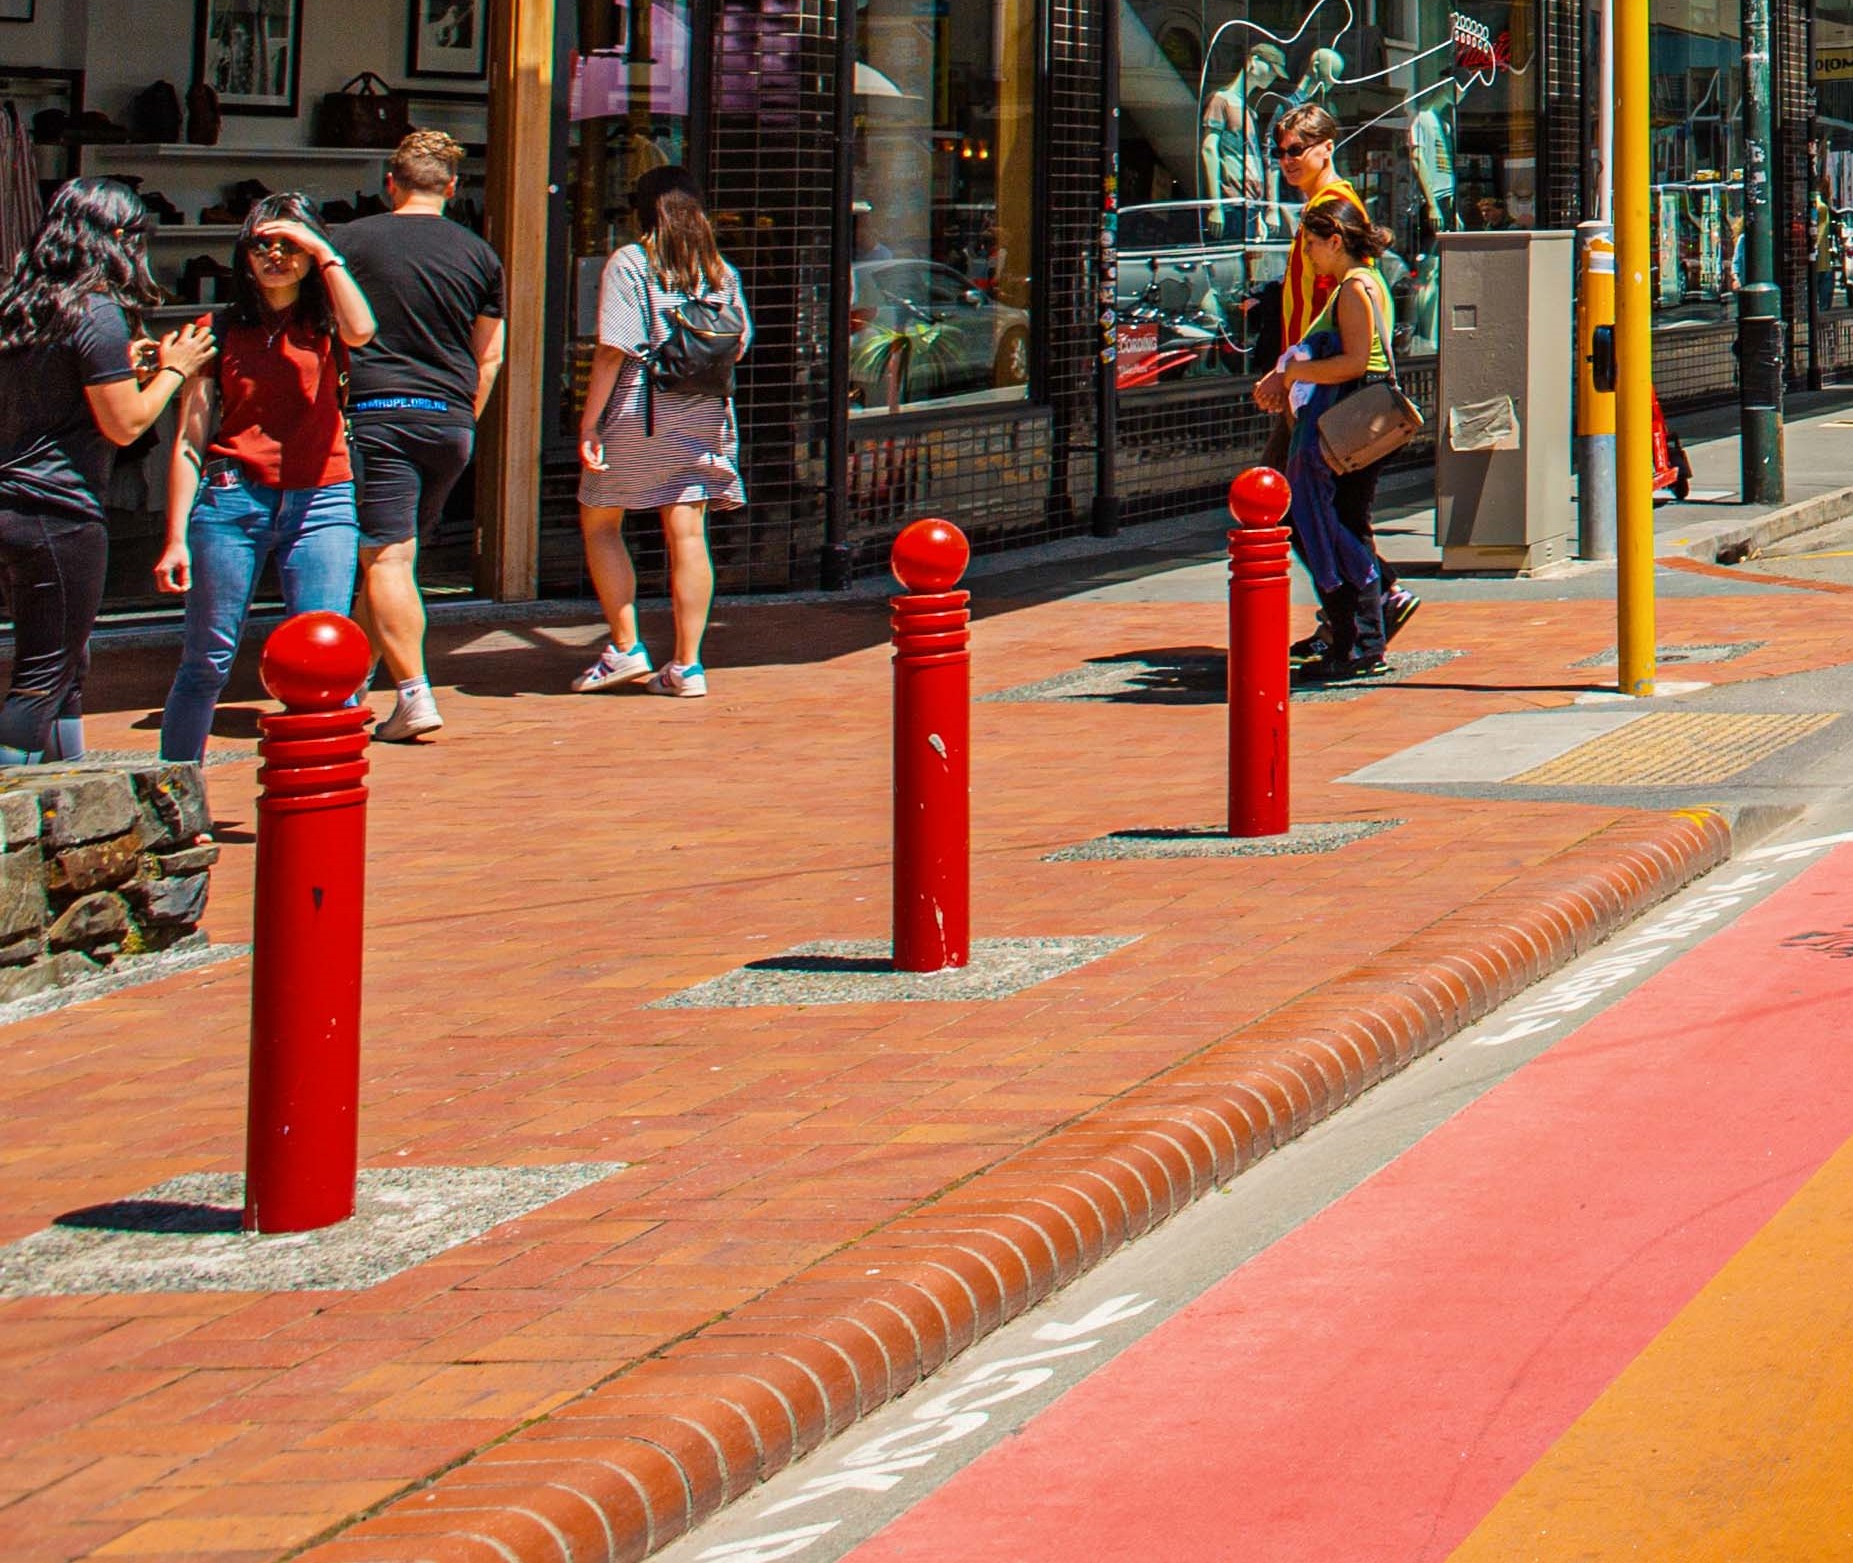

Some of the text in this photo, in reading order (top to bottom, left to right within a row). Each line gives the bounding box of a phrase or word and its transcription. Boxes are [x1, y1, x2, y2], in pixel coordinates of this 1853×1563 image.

[1506, 886, 1757, 1023] LOOK RIGHT
[758, 1339, 1103, 1520] LOOK
